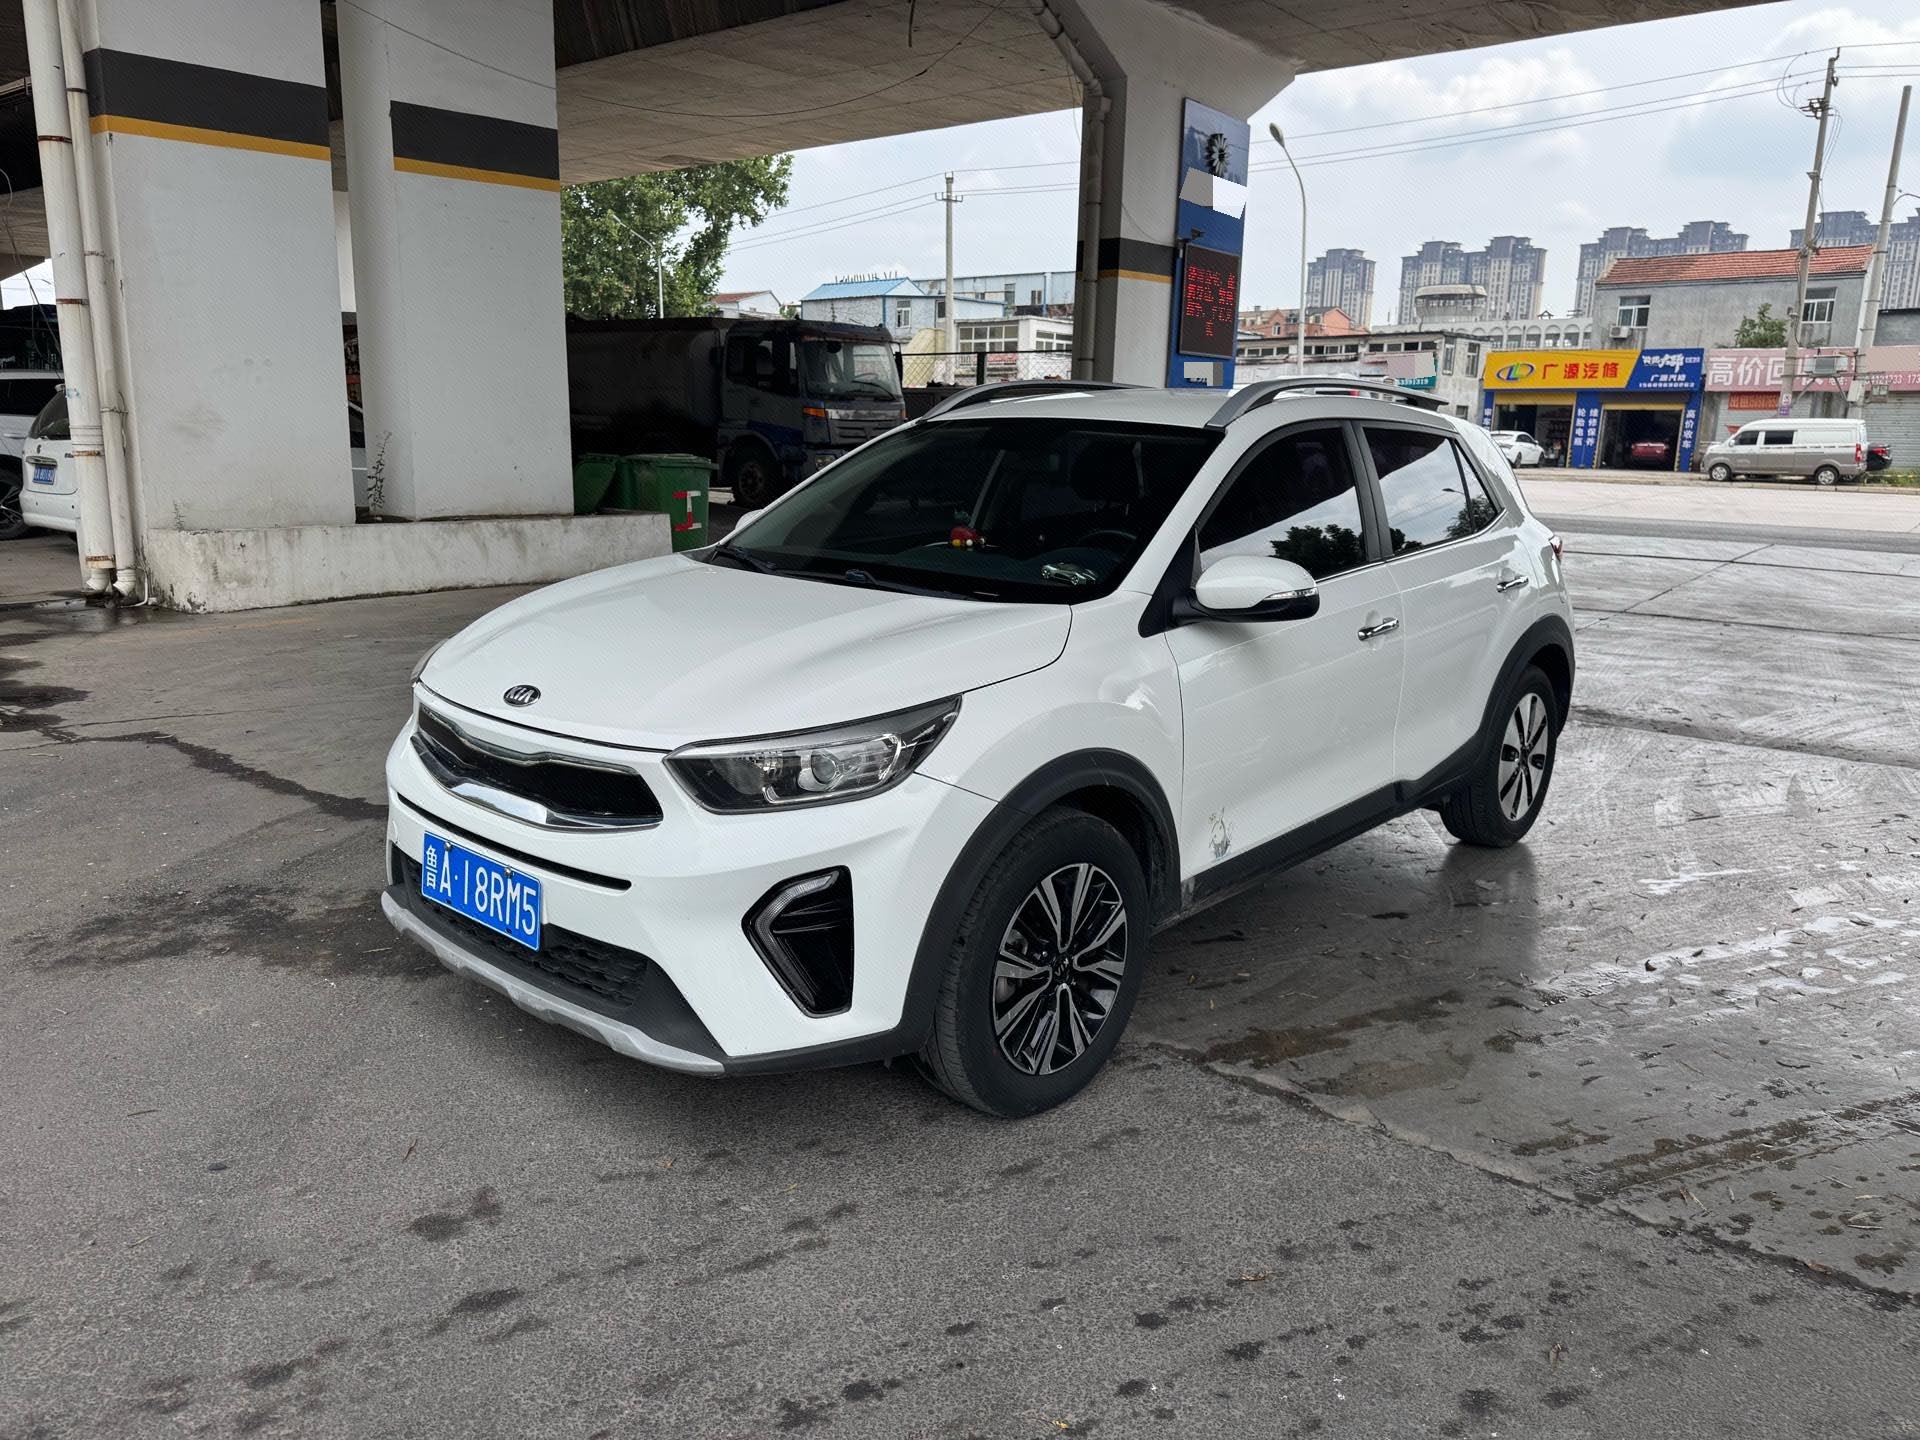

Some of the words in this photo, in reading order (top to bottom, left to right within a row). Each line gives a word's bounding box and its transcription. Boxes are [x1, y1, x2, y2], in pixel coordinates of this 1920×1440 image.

[1541, 361, 1620, 380] 广源汽修
[506, 687, 534, 703] KIA
